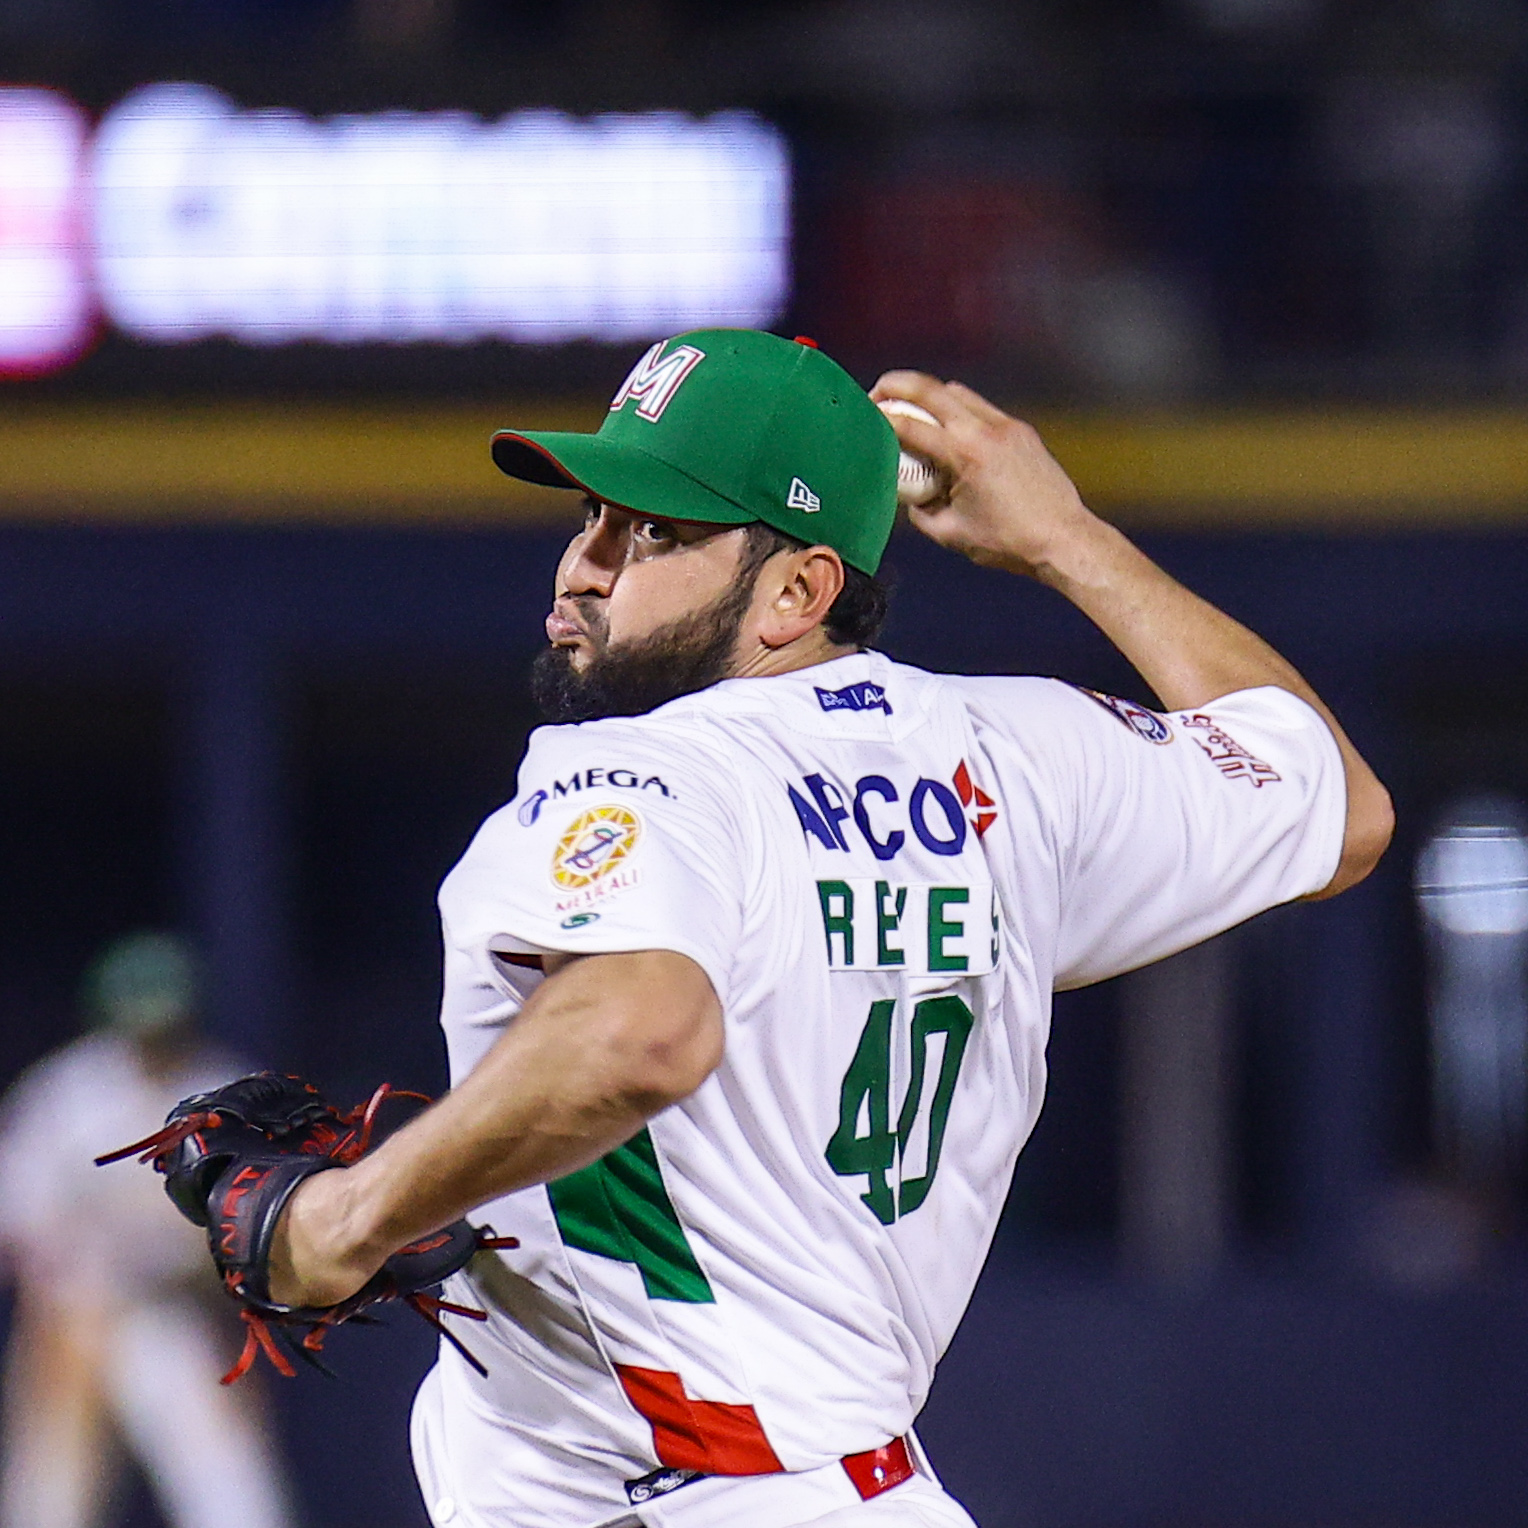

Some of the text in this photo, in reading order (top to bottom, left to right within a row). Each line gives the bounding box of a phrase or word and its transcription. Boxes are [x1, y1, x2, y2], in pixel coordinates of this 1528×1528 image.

[610, 339, 706, 423] M
[816, 880, 1000, 972] REE
[824, 995, 975, 1226] 40
